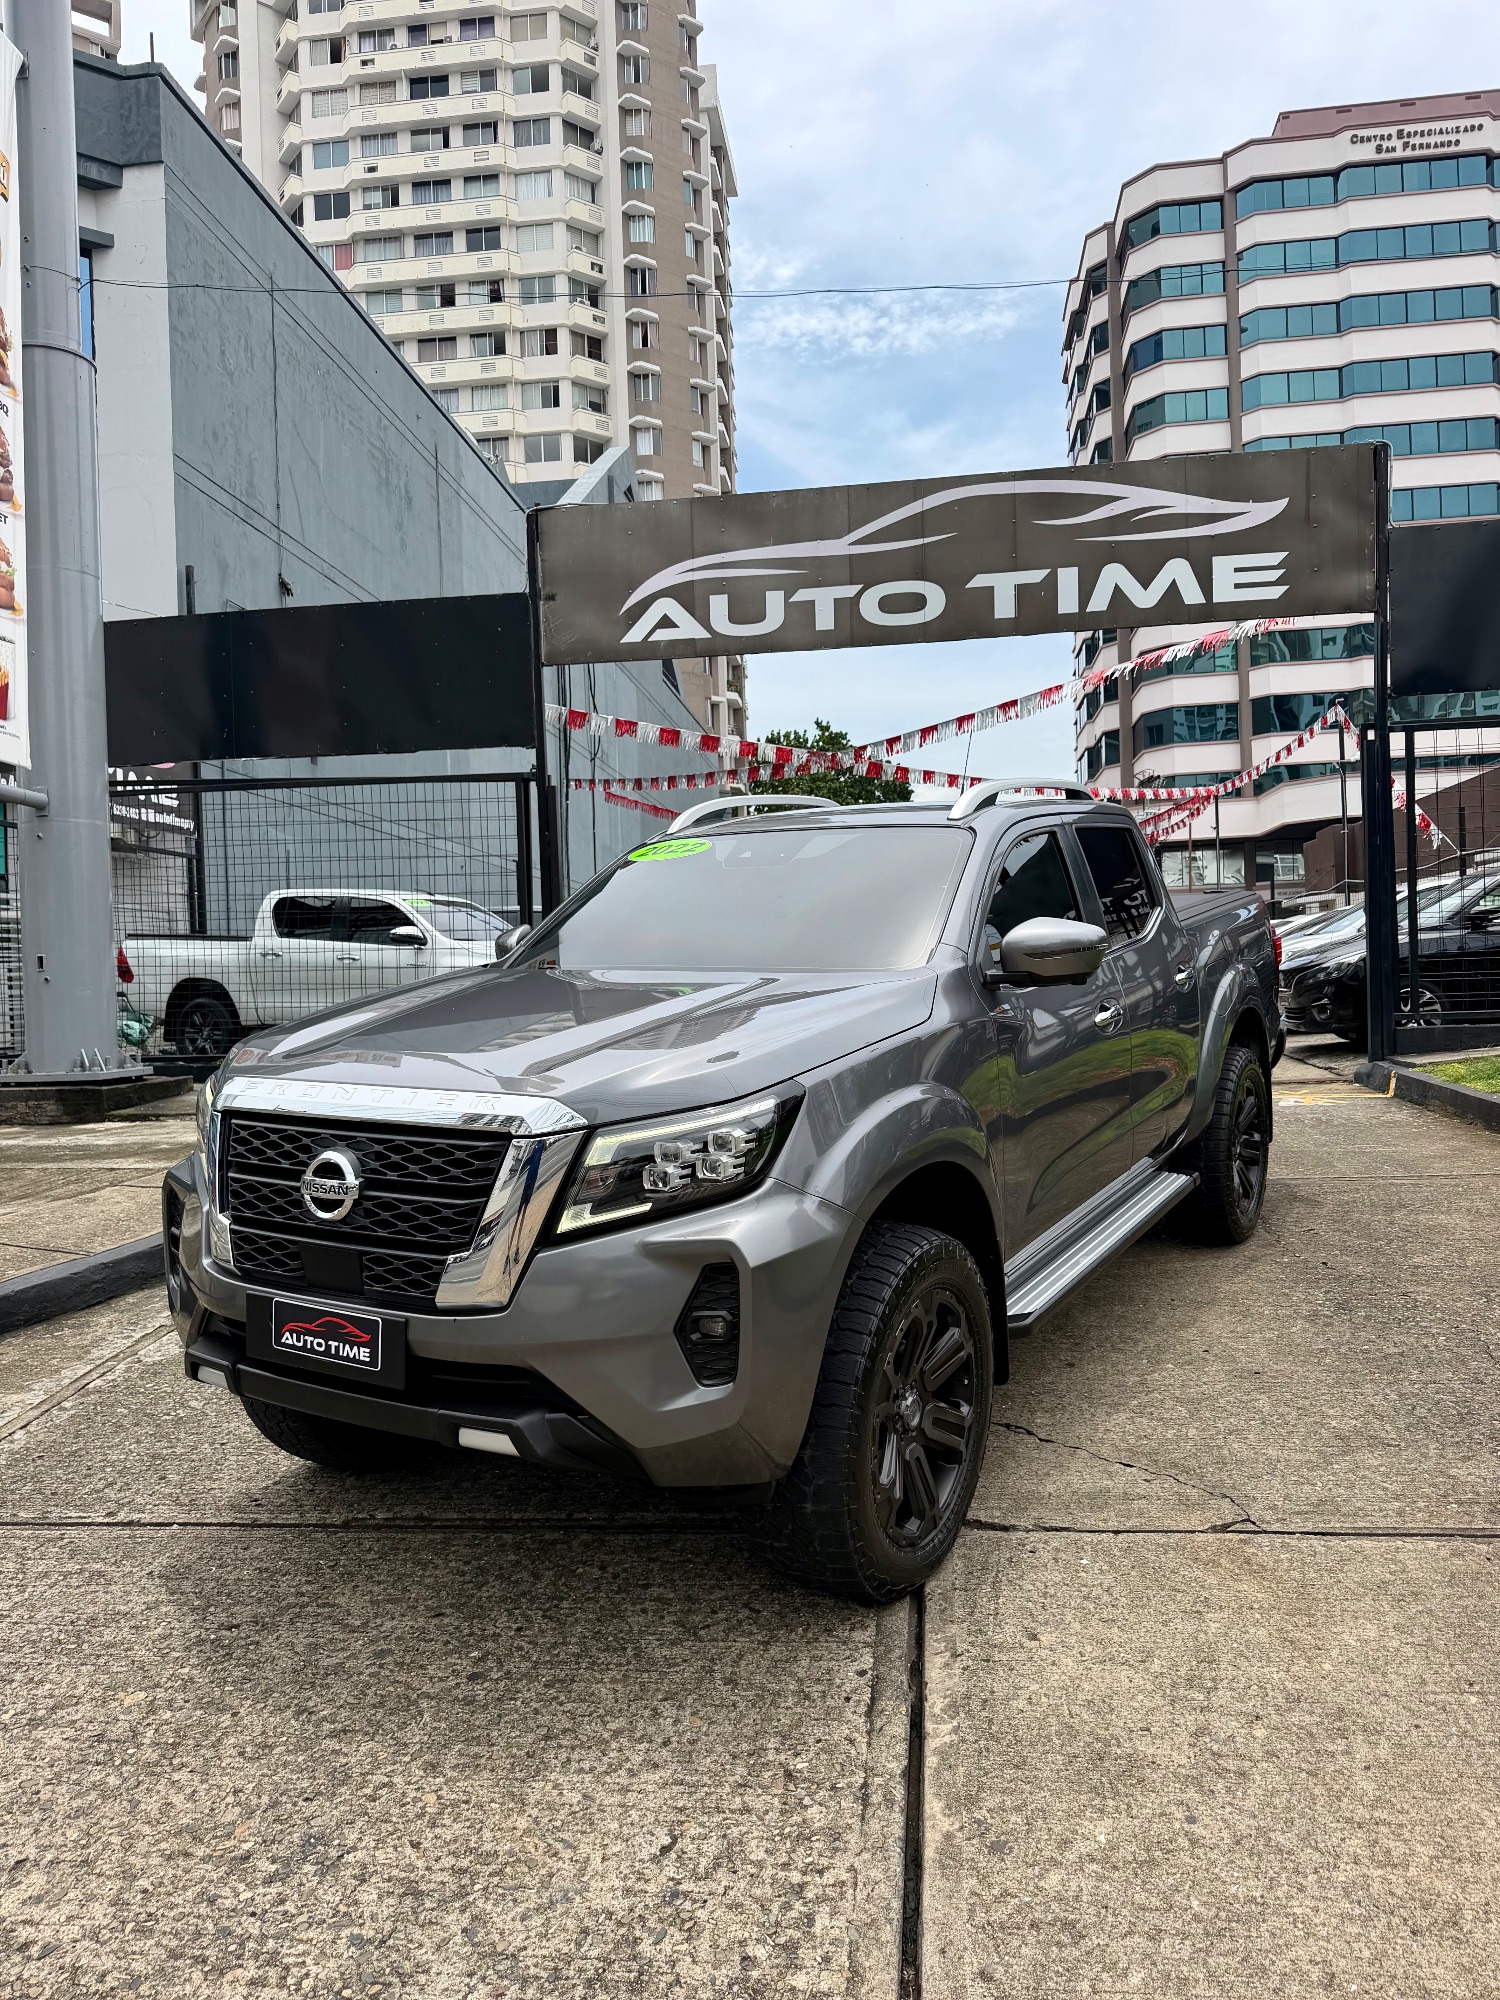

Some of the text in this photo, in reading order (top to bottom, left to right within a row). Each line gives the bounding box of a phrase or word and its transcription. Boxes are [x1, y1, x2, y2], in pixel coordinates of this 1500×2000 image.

[1350, 122, 1484, 144] CENTRO ESPECIALIZADO
[1375, 139, 1461, 154] SAN FERNANDO
[619, 551, 1290, 645] AUTO TIME
[635, 841, 706, 859] 2022
[240, 1081, 501, 1111] FRONTIER
[302, 1180, 349, 1196] NISSAN
[281, 1331, 371, 1362] AUTO TIME
